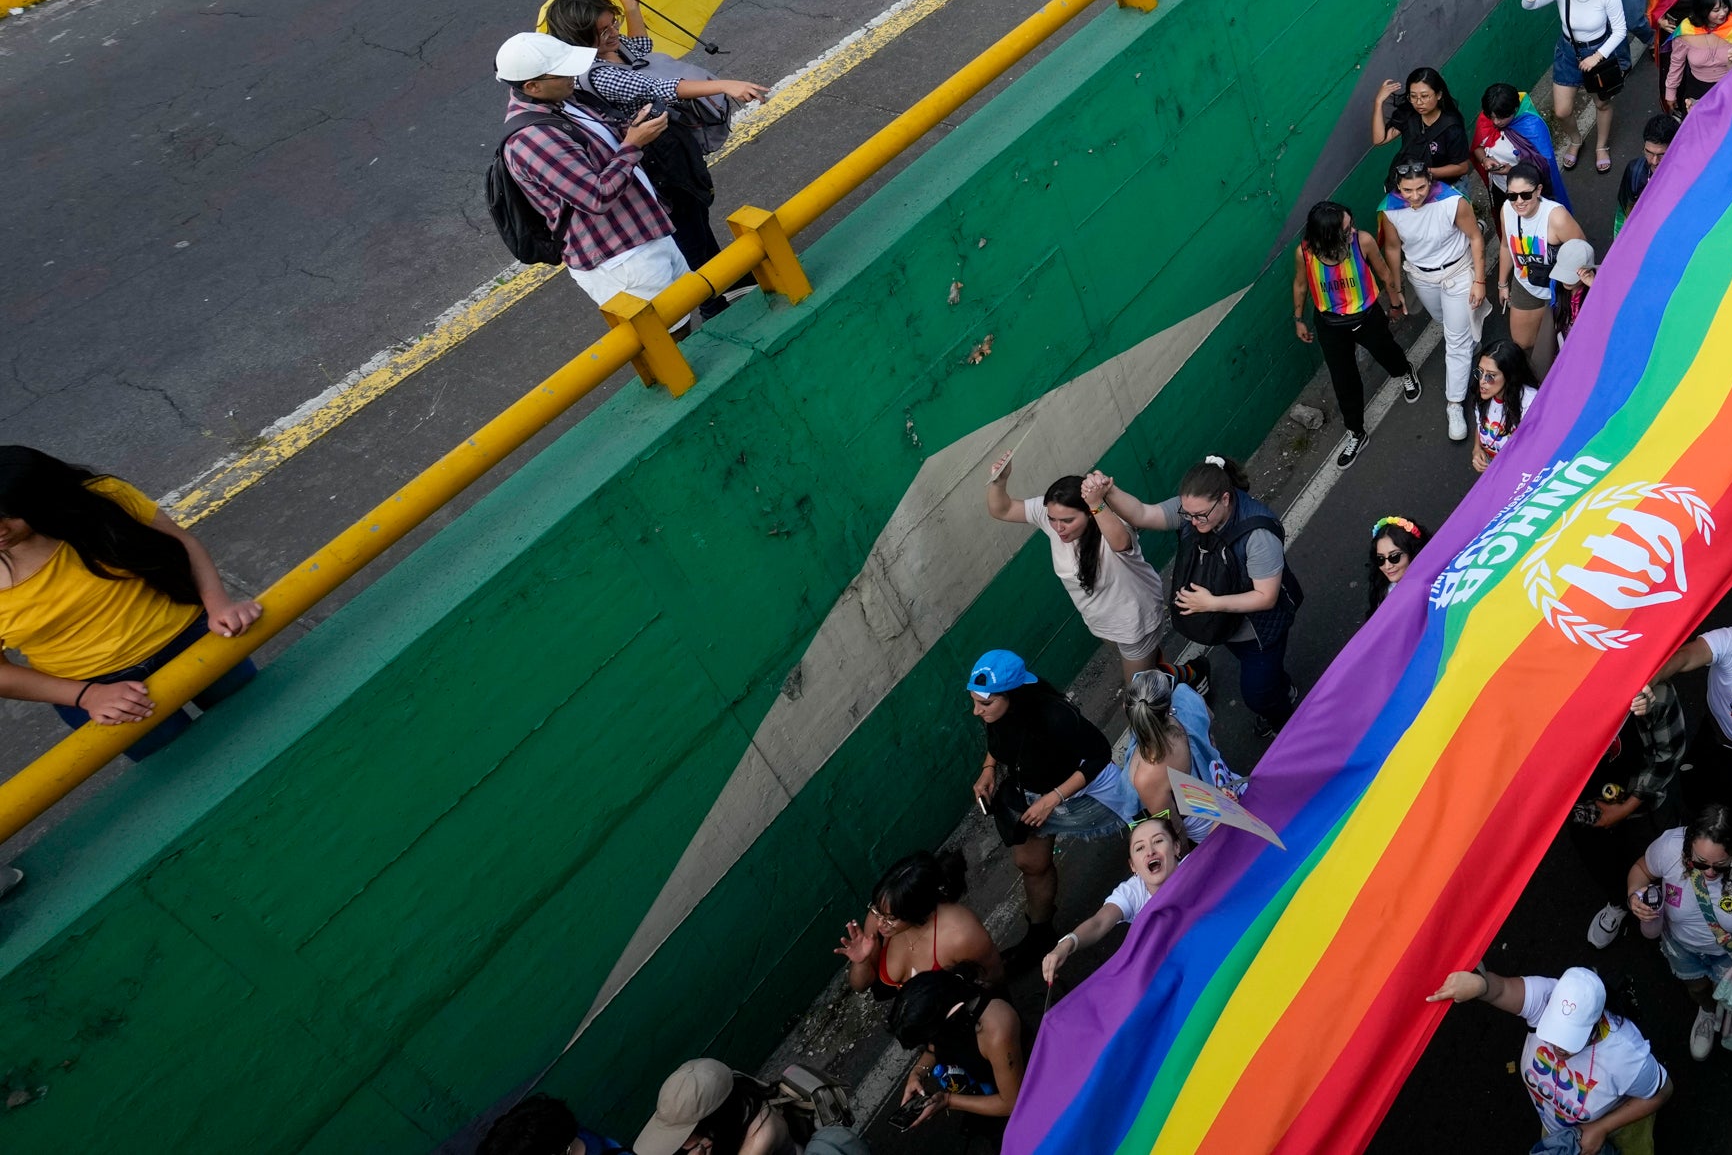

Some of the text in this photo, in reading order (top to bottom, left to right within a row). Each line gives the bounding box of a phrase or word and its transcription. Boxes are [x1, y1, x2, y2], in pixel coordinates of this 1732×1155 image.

[1320, 277, 1356, 293] MADRID
[1450, 455, 1612, 606] UNHCR
[1525, 1068, 1591, 1122] COMO
[1533, 1046, 1598, 1105] SOY
